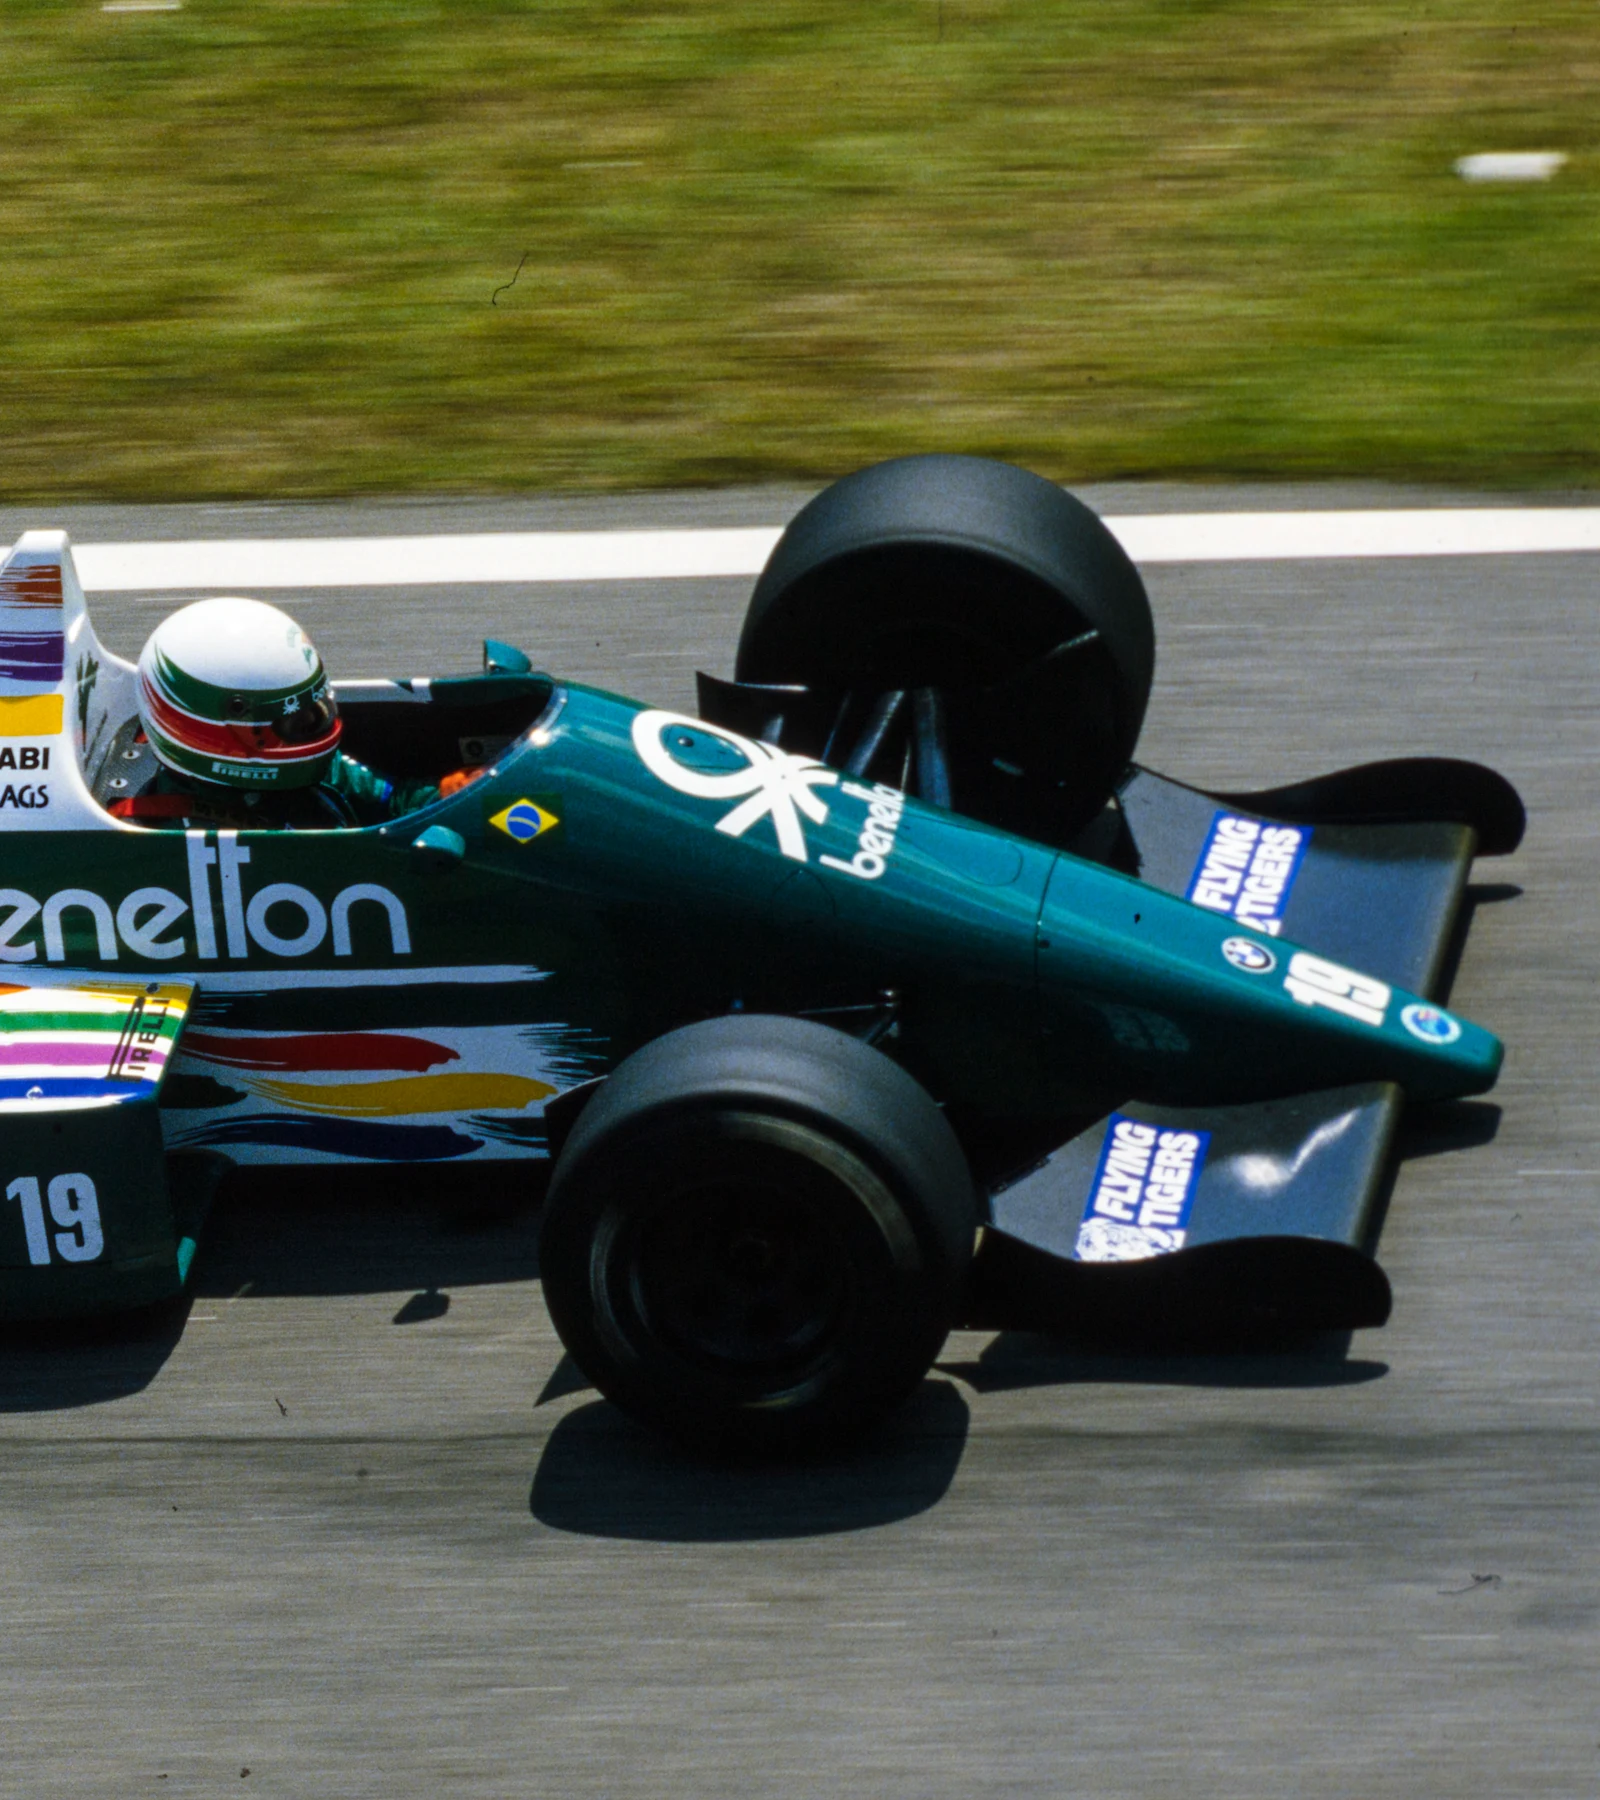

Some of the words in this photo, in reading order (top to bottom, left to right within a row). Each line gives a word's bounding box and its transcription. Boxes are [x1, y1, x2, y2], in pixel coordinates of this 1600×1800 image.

[211, 761, 280, 780] PIRELLI
[1191, 816, 1261, 911] FLYING
[1235, 827, 1303, 917] TIGERS
[1282, 951, 1392, 1027] 19
[105, 996, 172, 1083] PIRELLI
[1093, 1121, 1157, 1221] FLYING
[1138, 1131, 1201, 1226] TIGERS
[5, 1171, 105, 1266] 19
